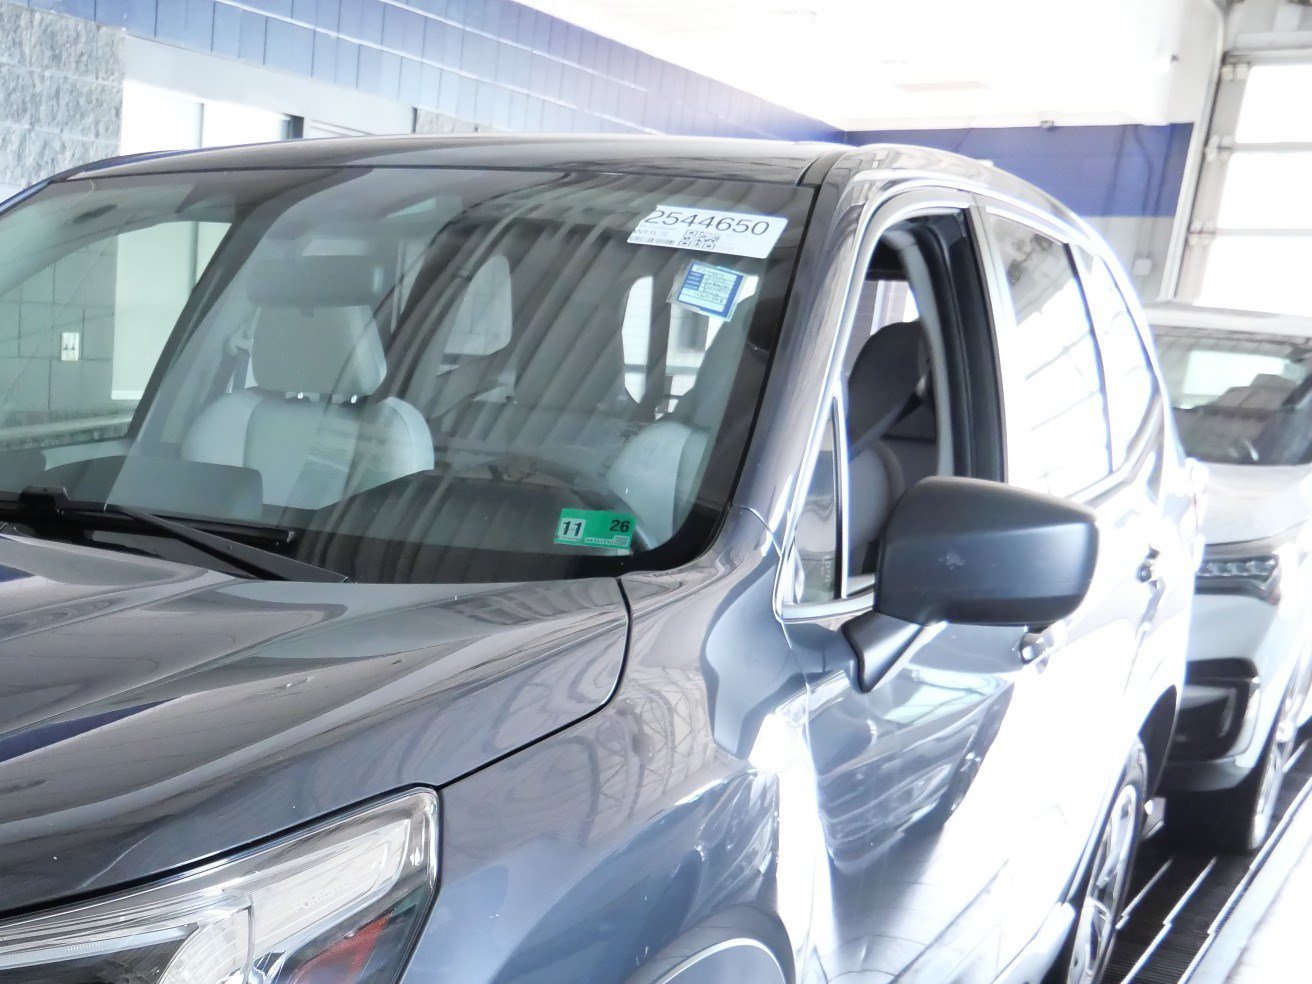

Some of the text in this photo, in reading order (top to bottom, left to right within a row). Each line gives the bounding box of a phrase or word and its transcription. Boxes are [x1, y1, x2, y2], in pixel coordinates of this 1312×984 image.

[644, 210, 770, 235] 2544650
[562, 519, 631, 537] 11 26
